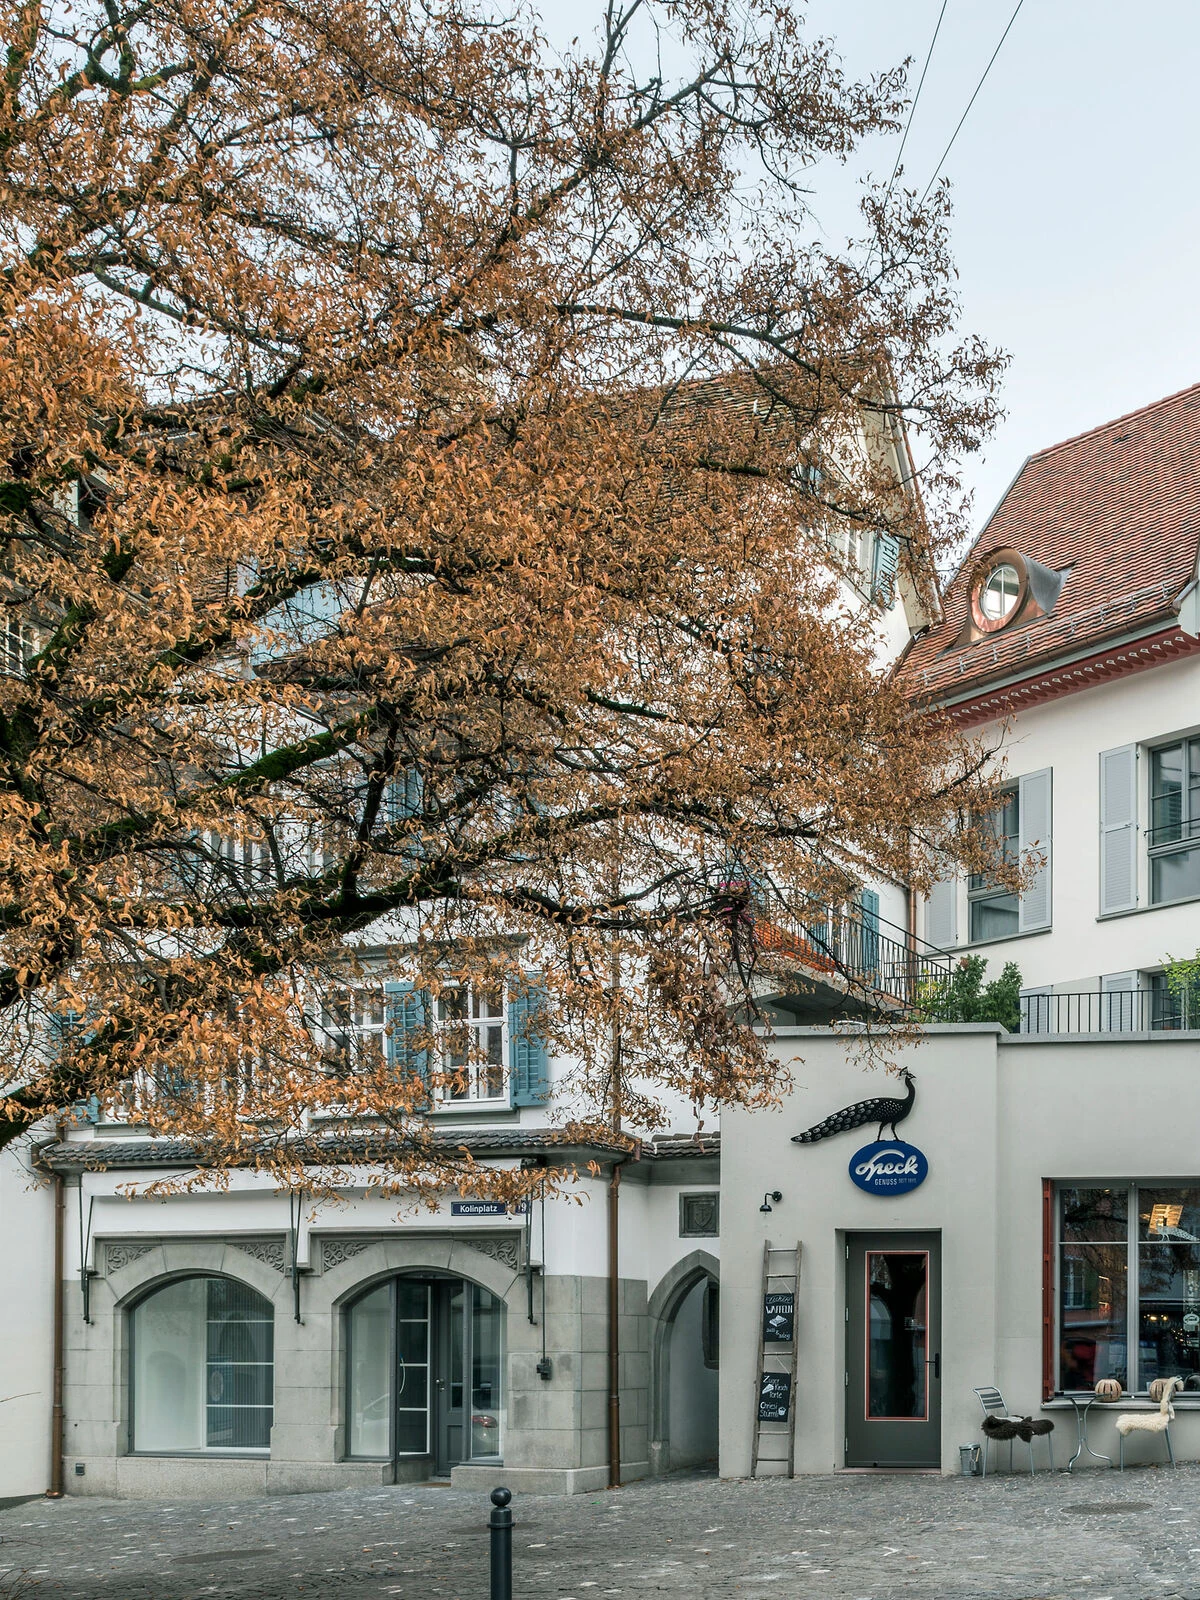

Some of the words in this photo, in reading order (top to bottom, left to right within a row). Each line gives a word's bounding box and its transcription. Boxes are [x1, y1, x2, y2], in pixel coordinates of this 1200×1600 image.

[855, 1149, 919, 1181] Speck
[874, 1178, 897, 1186] GENUSS
[460, 1204, 498, 1214] Kolinplatz
